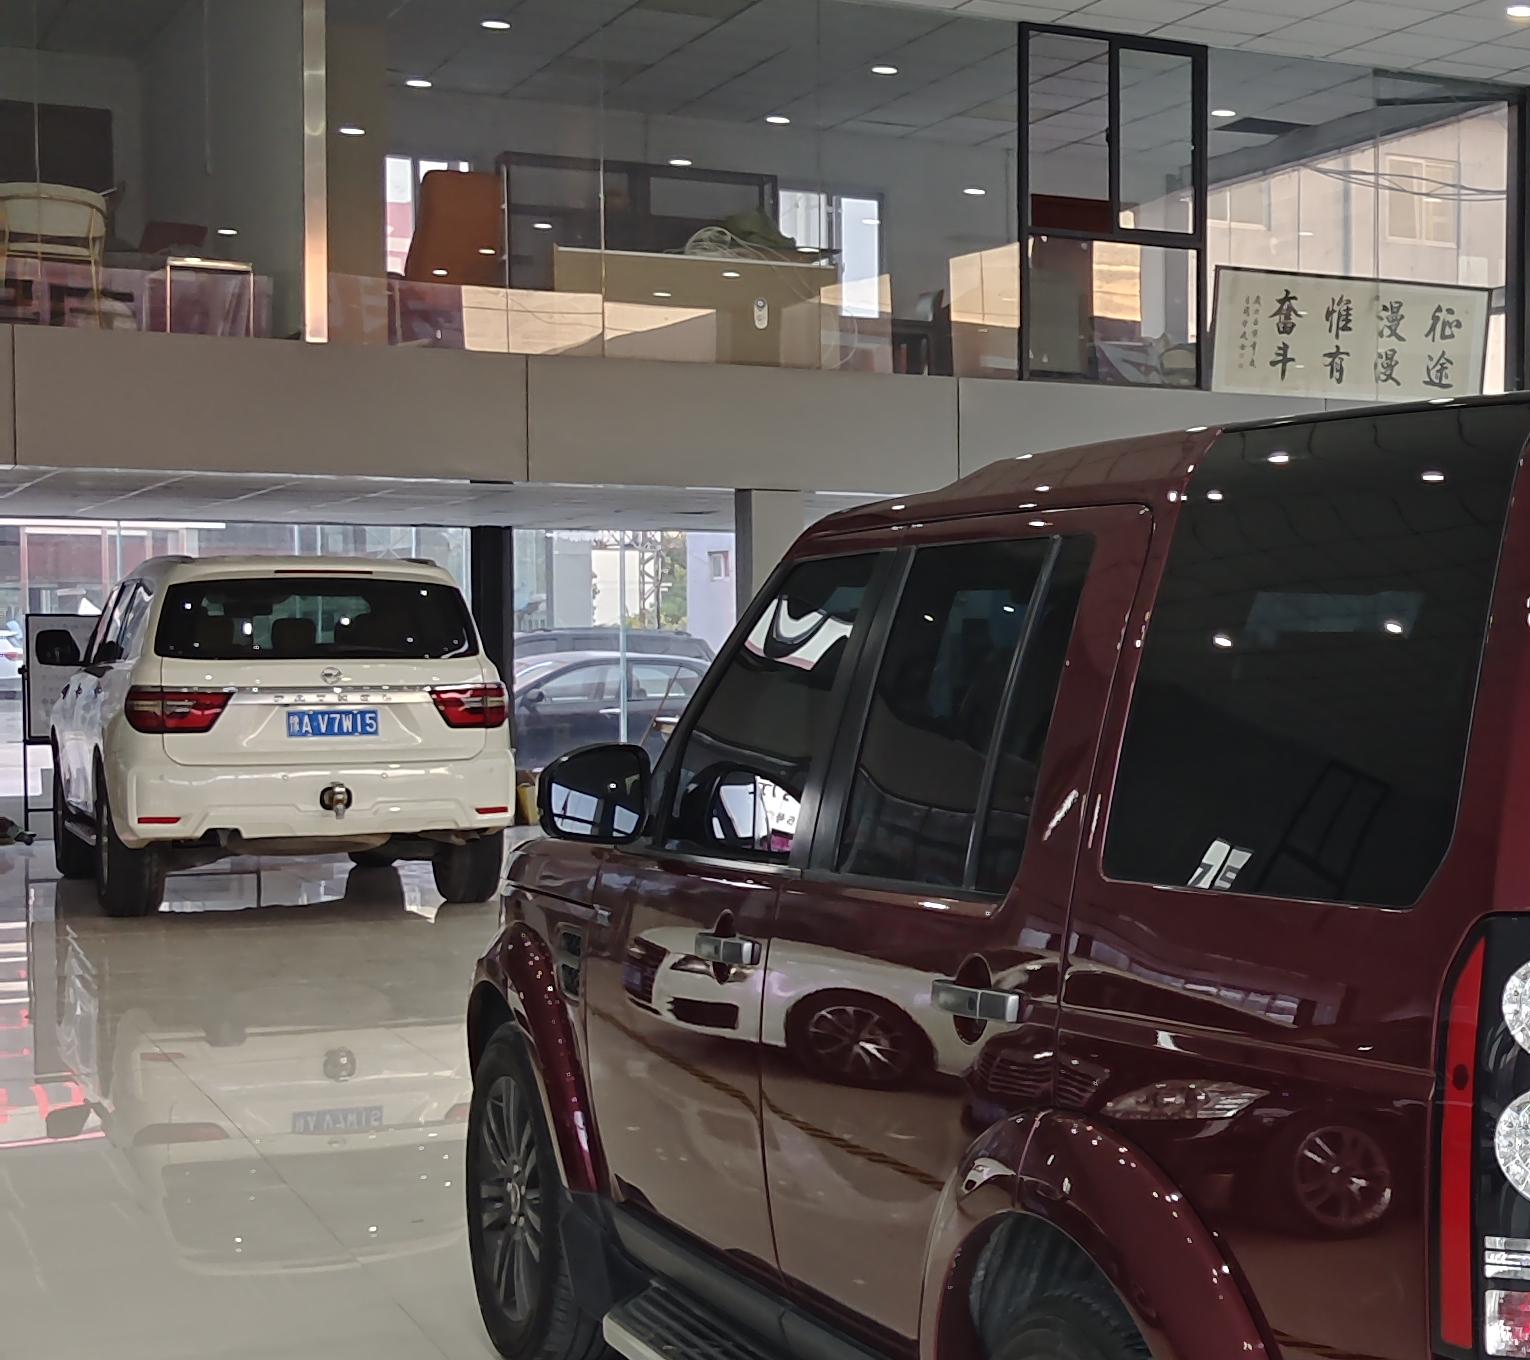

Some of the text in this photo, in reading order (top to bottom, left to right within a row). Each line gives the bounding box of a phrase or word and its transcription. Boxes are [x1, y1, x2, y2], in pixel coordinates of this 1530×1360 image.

[1323, 294, 1353, 385] 惟有
[1374, 300, 1406, 387] 漫漫
[1422, 304, 1462, 389] 征途
